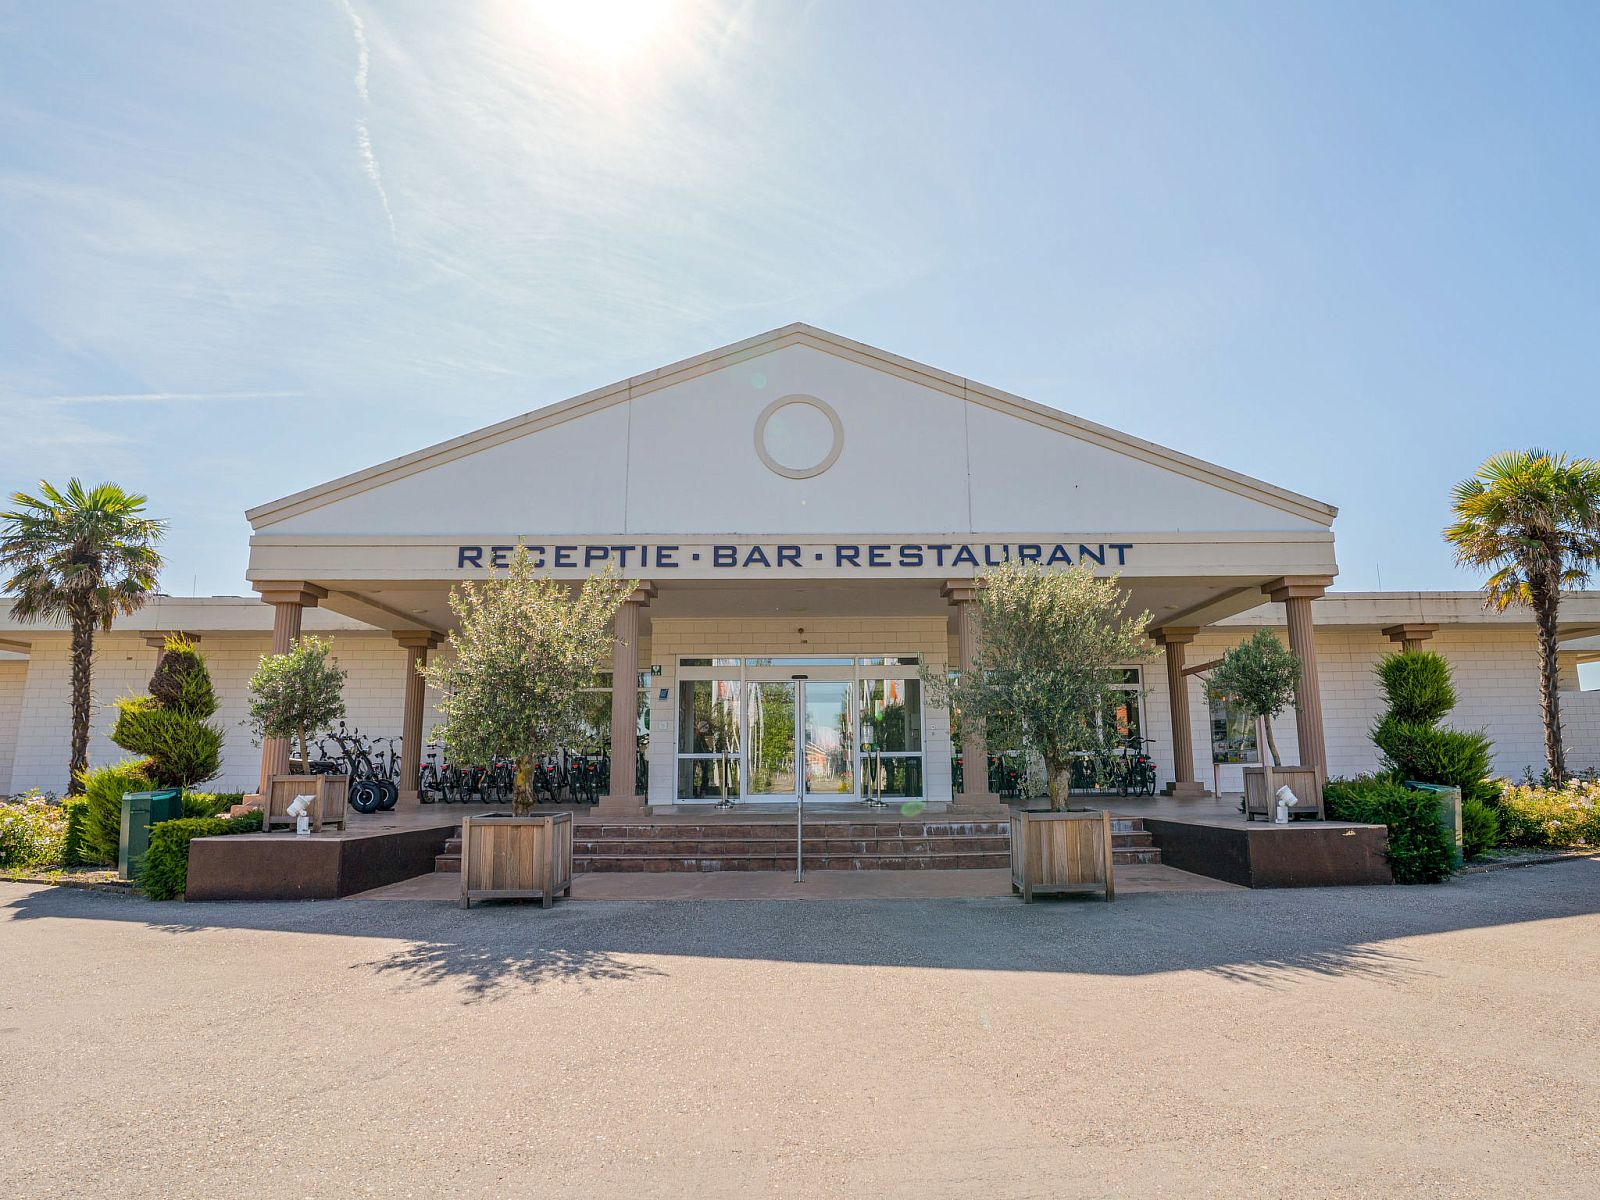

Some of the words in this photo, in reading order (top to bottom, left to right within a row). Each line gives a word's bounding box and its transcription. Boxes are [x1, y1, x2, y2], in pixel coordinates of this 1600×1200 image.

[458, 546, 679, 568] RECEPTIE
[713, 545, 803, 567] BAR
[836, 544, 1134, 567] RESTAURANT
